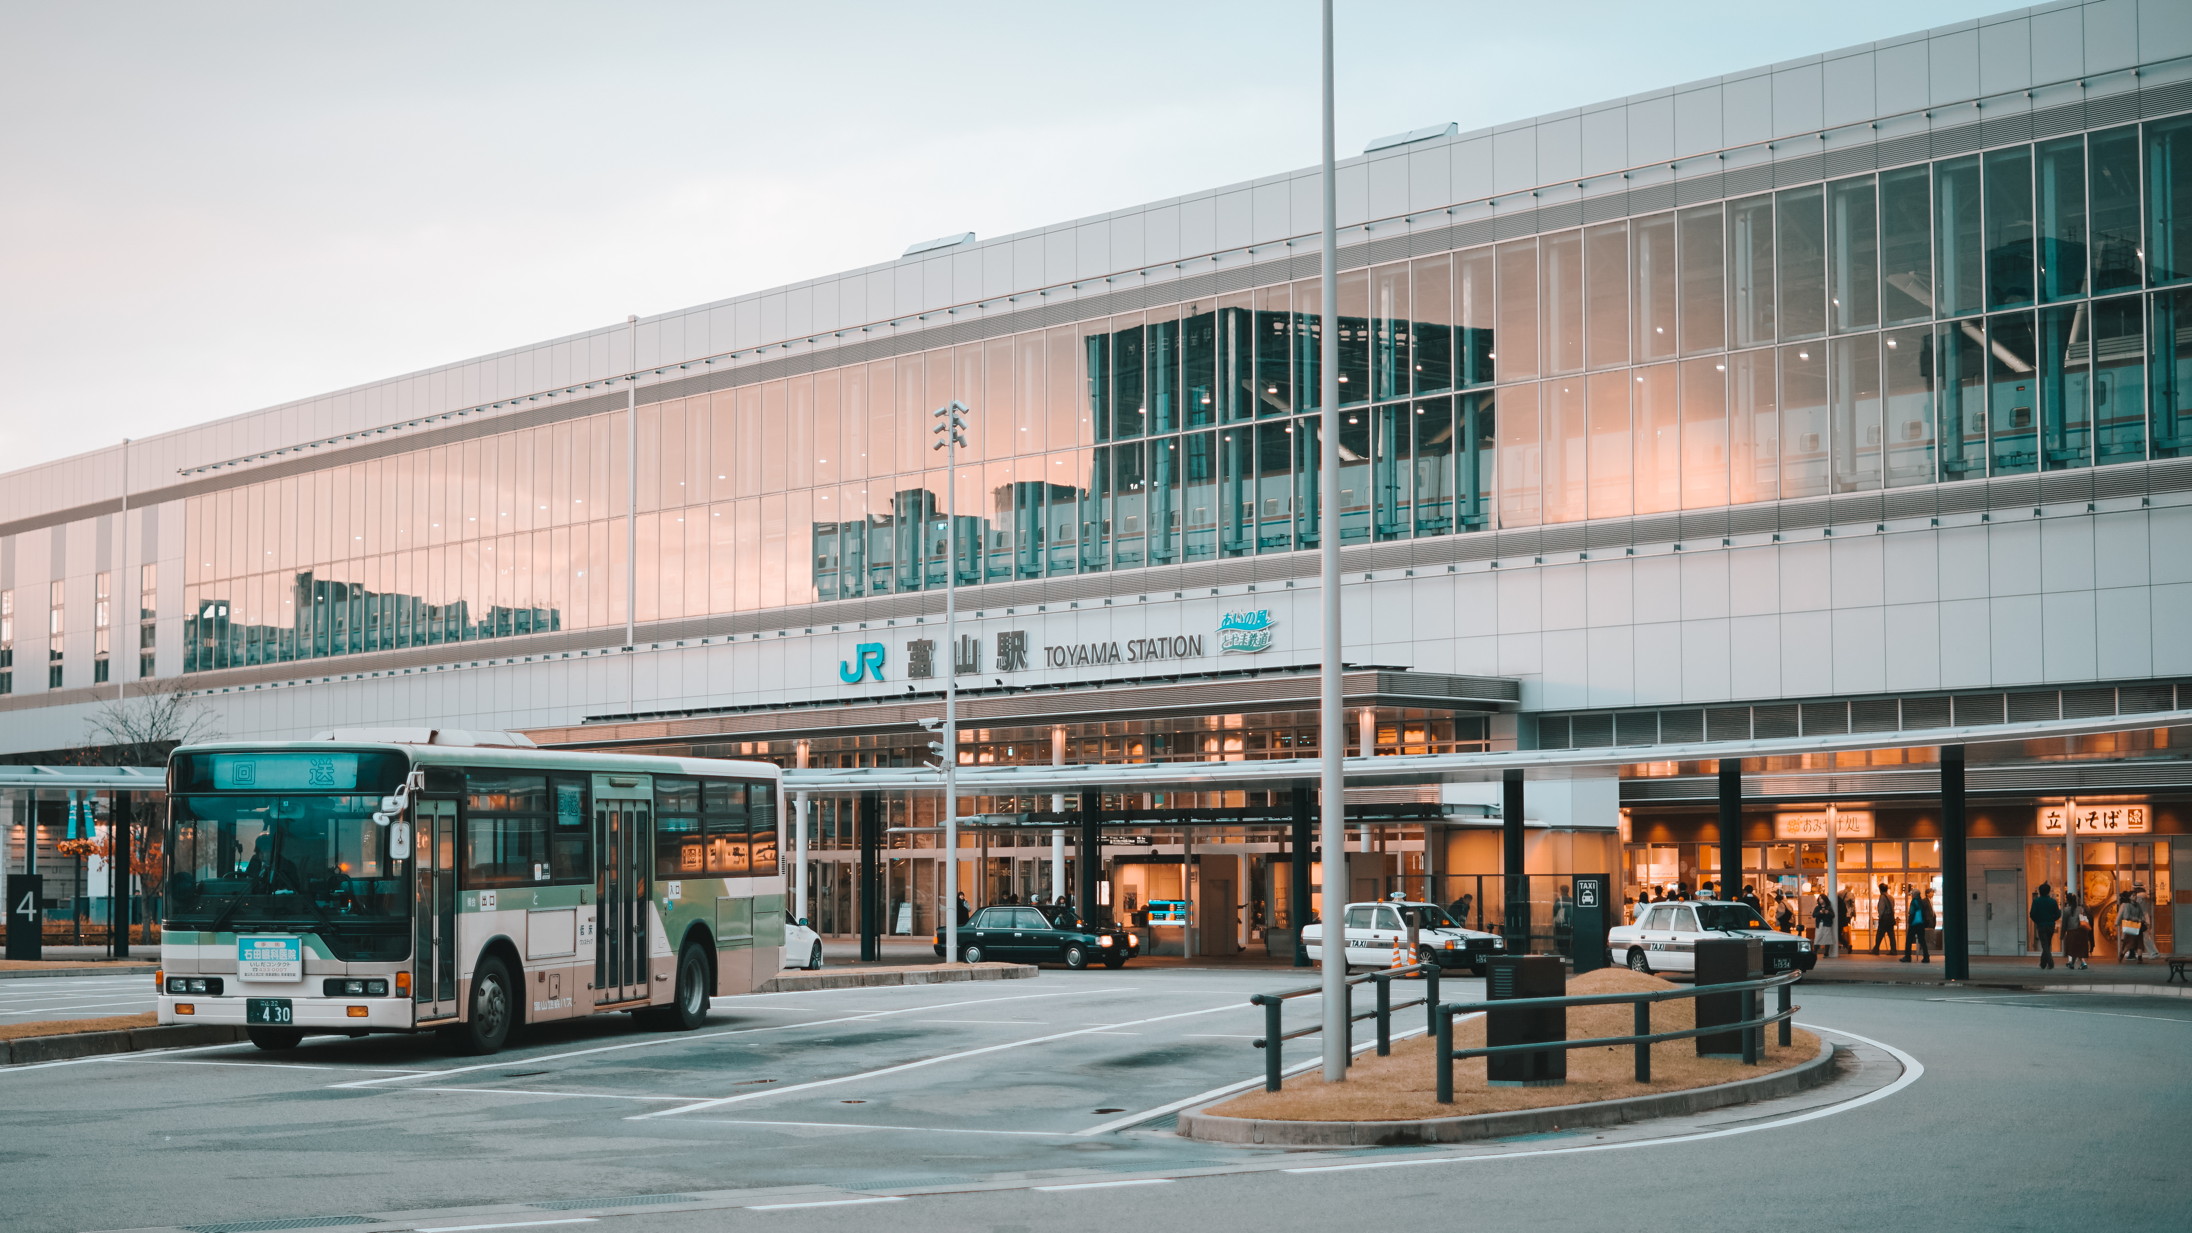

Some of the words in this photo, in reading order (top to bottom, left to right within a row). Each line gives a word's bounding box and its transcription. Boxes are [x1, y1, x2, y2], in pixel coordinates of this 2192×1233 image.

[1221, 609, 1271, 627] あいの風
[1222, 631, 1270, 648] とやま鉄道
[907, 629, 1028, 679] 富山駅
[1044, 641, 1122, 668] TOYAMA
[1126, 634, 1203, 663] STATION
[840, 642, 885, 684] JR
[232, 758, 336, 785] 回送
[670, 885, 680, 895] 入口
[16, 891, 37, 922] 4
[482, 895, 494, 907] 出口
[1351, 940, 1367, 948] TAXI
[1651, 943, 1665, 951] TAXI
[244, 949, 297, 960] 石田眼科医院
